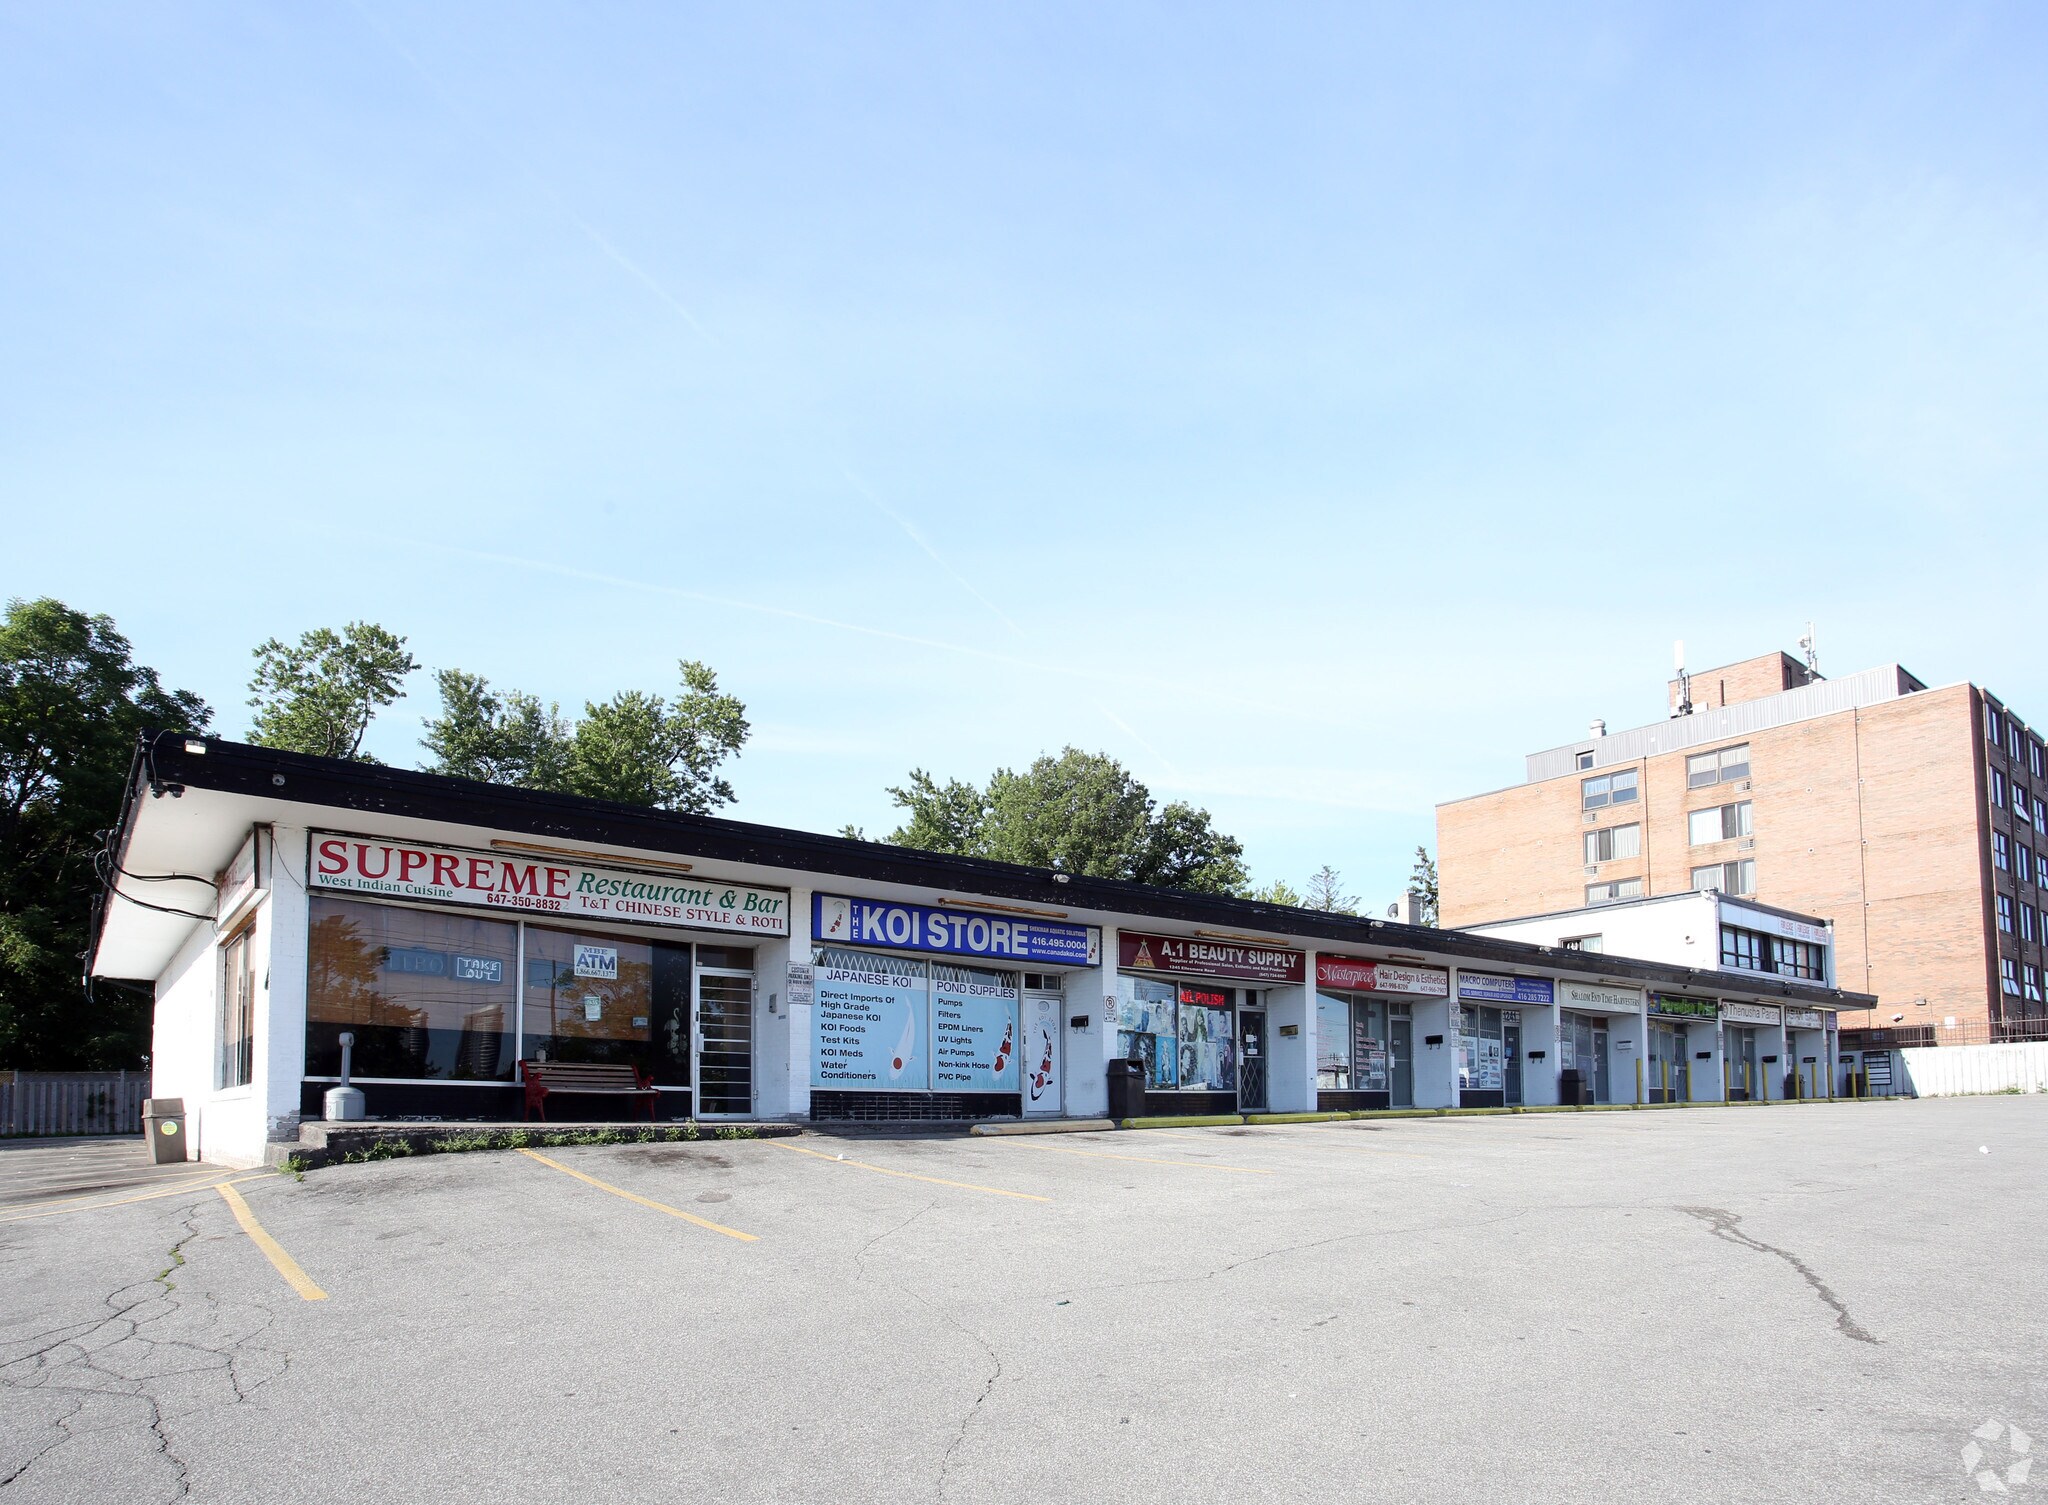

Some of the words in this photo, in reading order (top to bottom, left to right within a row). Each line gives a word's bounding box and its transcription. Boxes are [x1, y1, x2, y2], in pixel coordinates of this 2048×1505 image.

[318, 840, 571, 900] SUPREME
[318, 874, 352, 887] West
[357, 878, 400, 893] Indian
[405, 884, 454, 899] Cuisine
[576, 872, 713, 907] Restaurant
[719, 890, 737, 910] &
[743, 892, 783, 914] Bar
[487, 893, 561, 910] 647-350-8832
[580, 896, 609, 910] T&T
[616, 900, 681, 918] CHINESE
[686, 908, 731, 923] STYLE
[735, 914, 746, 926] &
[751, 916, 783, 930] ROTI
[862, 905, 920, 945] KOI
[927, 912, 1029, 955] STORE
[1032, 937, 1087, 950] 416.495.0004
[584, 947, 608, 955] MBE
[1032, 948, 1087, 958] www.canadakoi.com
[1189, 944, 1245, 963] BEAUTY
[1248, 950, 1297, 968] SUPPLY
[462, 958, 498, 971] TAKE
[576, 953, 616, 970] ATM
[465, 969, 494, 980] OUT
[576, 968, 616, 978] 1.866.667.1377
[1379, 969, 1392, 980] Hair
[1393, 971, 1415, 983] Design
[1416, 975, 1420, 983] &
[1420, 974, 1447, 986] Esthetics
[826, 970, 889, 986] JAPANESE
[892, 976, 912, 988] KOI
[1460, 974, 1480, 985] MACRO
[1481, 977, 1515, 989] COMPUTERS
[936, 981, 967, 994] POND
[969, 984, 1015, 998] SUPPLIES
[821, 991, 848, 1000] Direct
[850, 993, 883, 1003] Imports
[886, 996, 895, 1004] Of
[938, 998, 963, 1007] Pumps
[1196, 992, 1225, 1006] POLISH
[1518, 993, 1526, 1001] 416
[1592, 992, 1600, 1002] END
[1601, 993, 1613, 1004] TIME
[1614, 994, 1640, 1007] HARVESTERS
[821, 1001, 841, 1010] High
[843, 1002, 870, 1011] Grade
[1729, 1003, 1760, 1018] Thenusha
[821, 1011, 864, 1020] Japanese
[866, 1014, 881, 1022] KOI
[938, 1011, 961, 1019] Filters
[821, 1023, 837, 1031] KOI
[840, 1024, 866, 1033] Foods
[938, 1023, 960, 1031] EPDM
[961, 1024, 984, 1033] Liners
[821, 1036, 841, 1044] Test
[843, 1036, 860, 1045] Kits
[950, 1036, 973, 1045] Lights
[821, 1048, 837, 1056] KOI
[840, 1049, 864, 1058] Meds
[951, 1048, 975, 1057] Pumps
[821, 1061, 847, 1069] Water
[938, 1060, 970, 1068] Non-kink
[972, 1062, 990, 1070] Hose
[821, 1071, 877, 1080] Conditioners
[955, 1074, 972, 1082] Pipe
